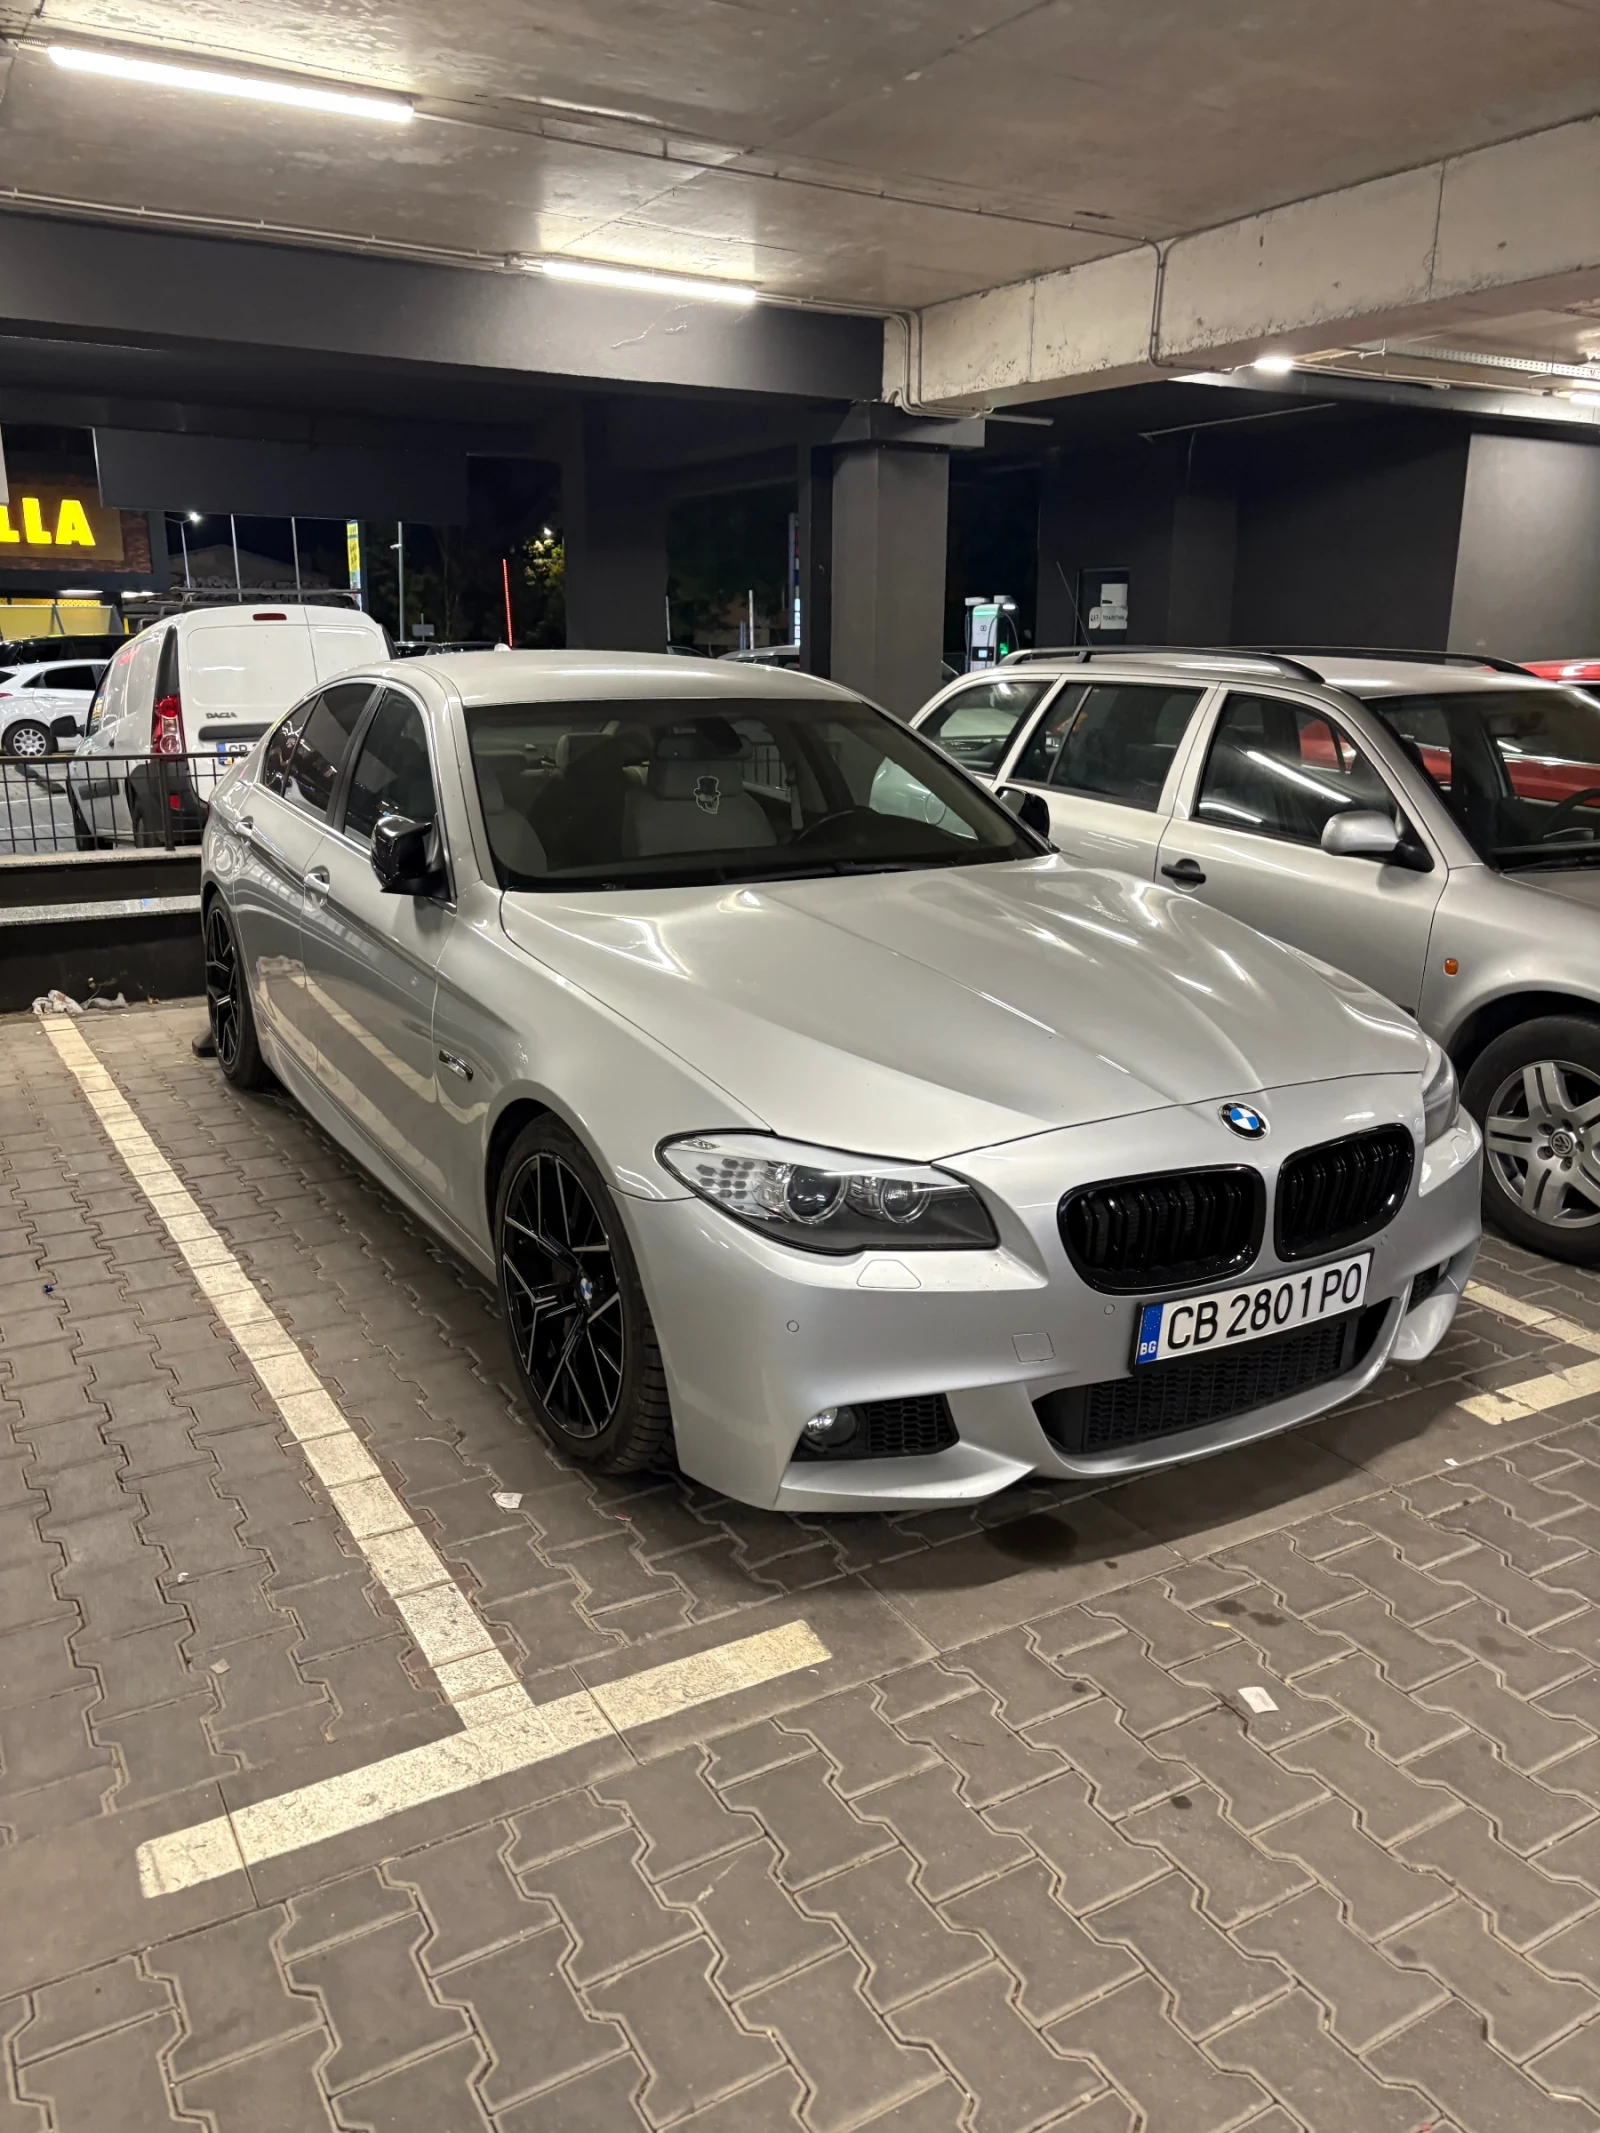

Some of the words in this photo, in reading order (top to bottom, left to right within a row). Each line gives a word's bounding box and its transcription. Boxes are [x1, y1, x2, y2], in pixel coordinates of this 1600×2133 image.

[205, 711, 238, 719] DACIA
[1167, 1300, 1218, 1350] CB
[1226, 1276, 1313, 1338] 2801
[1319, 1263, 1362, 1313] PO
[1139, 1341, 1157, 1356] BG
